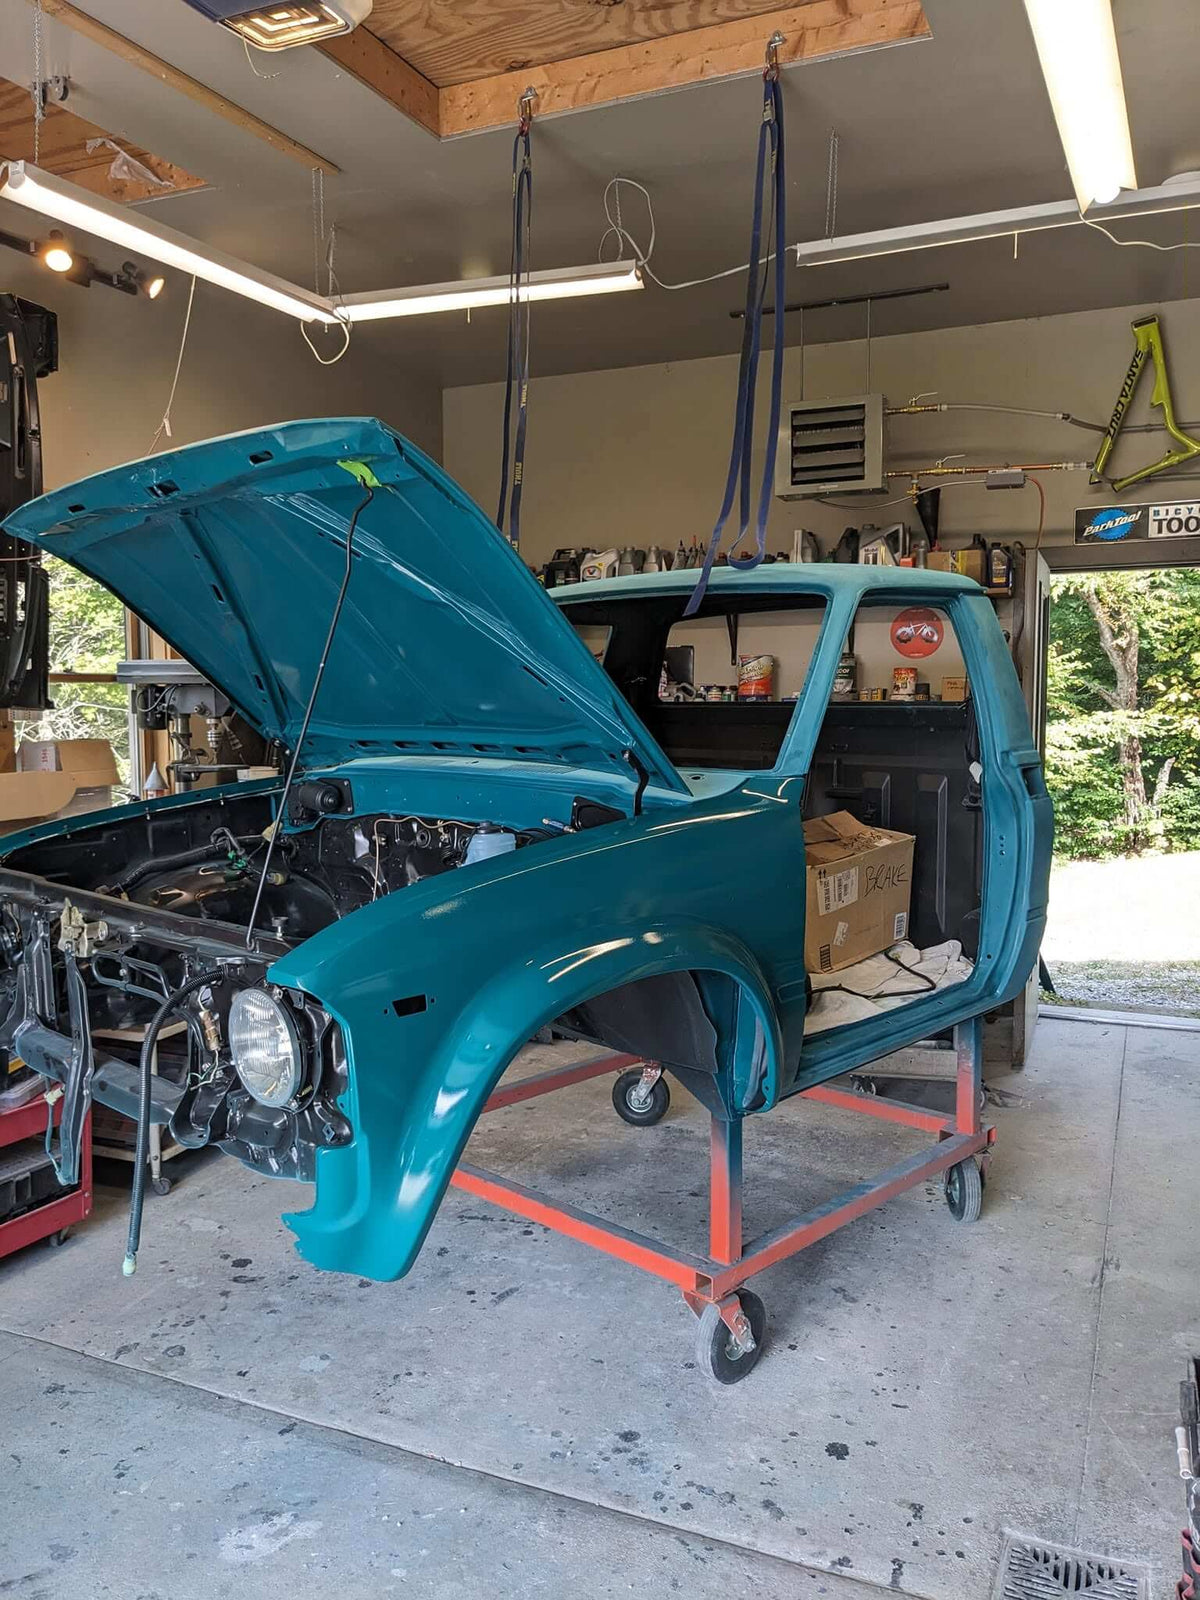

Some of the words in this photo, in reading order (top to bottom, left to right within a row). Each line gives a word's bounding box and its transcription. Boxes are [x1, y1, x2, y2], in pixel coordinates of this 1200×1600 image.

[1121, 348, 1144, 398] SANTA
[1106, 400, 1125, 440] CRUZ
[514, 462, 522, 486] THULE
[1153, 506, 1200, 517] BICY
[864, 864, 908, 897] BRAKE
